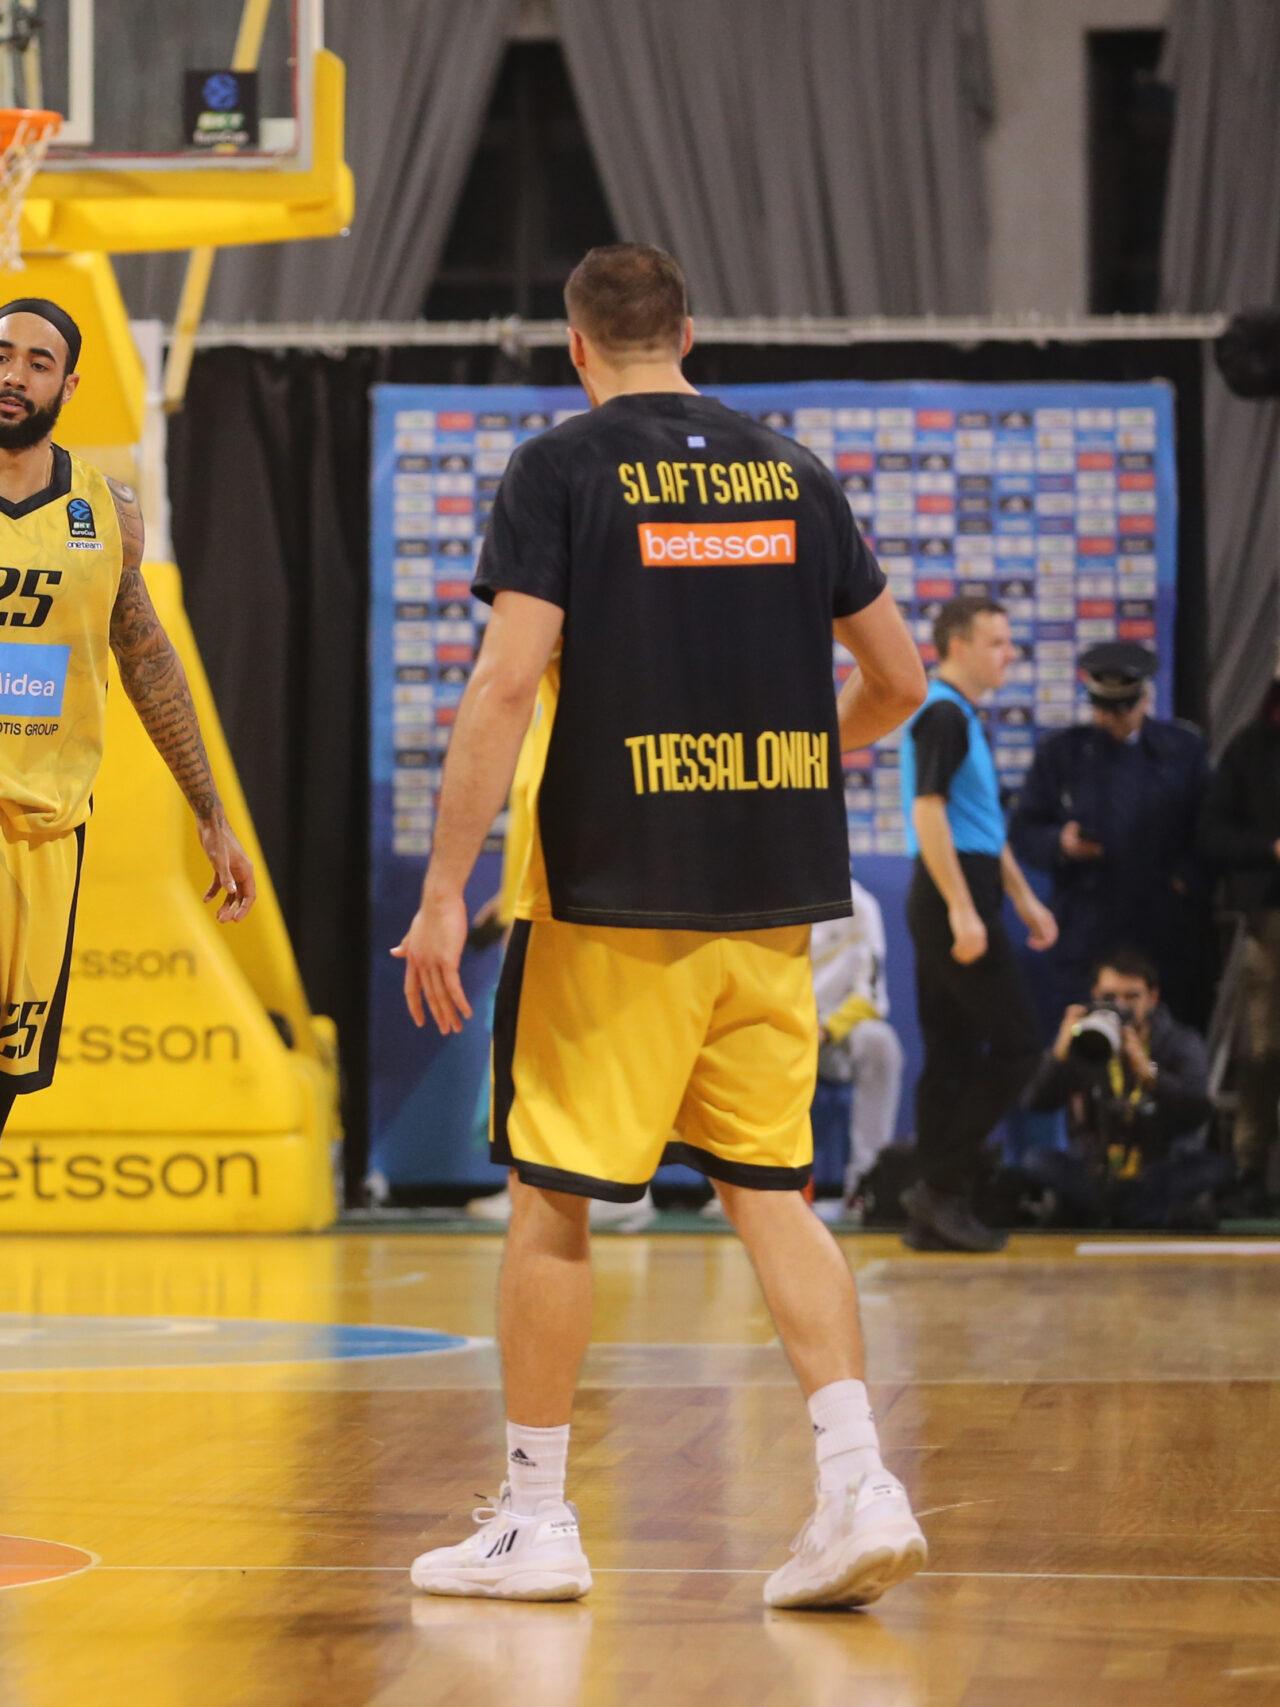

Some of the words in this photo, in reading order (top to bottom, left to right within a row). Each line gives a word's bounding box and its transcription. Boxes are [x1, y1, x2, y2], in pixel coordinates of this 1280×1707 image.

[618, 460, 800, 505] SLAFTSAKIS
[644, 530, 792, 560] betsson
[25, 723, 59, 736] GROUP
[625, 731, 829, 794] THESSALONIKI
